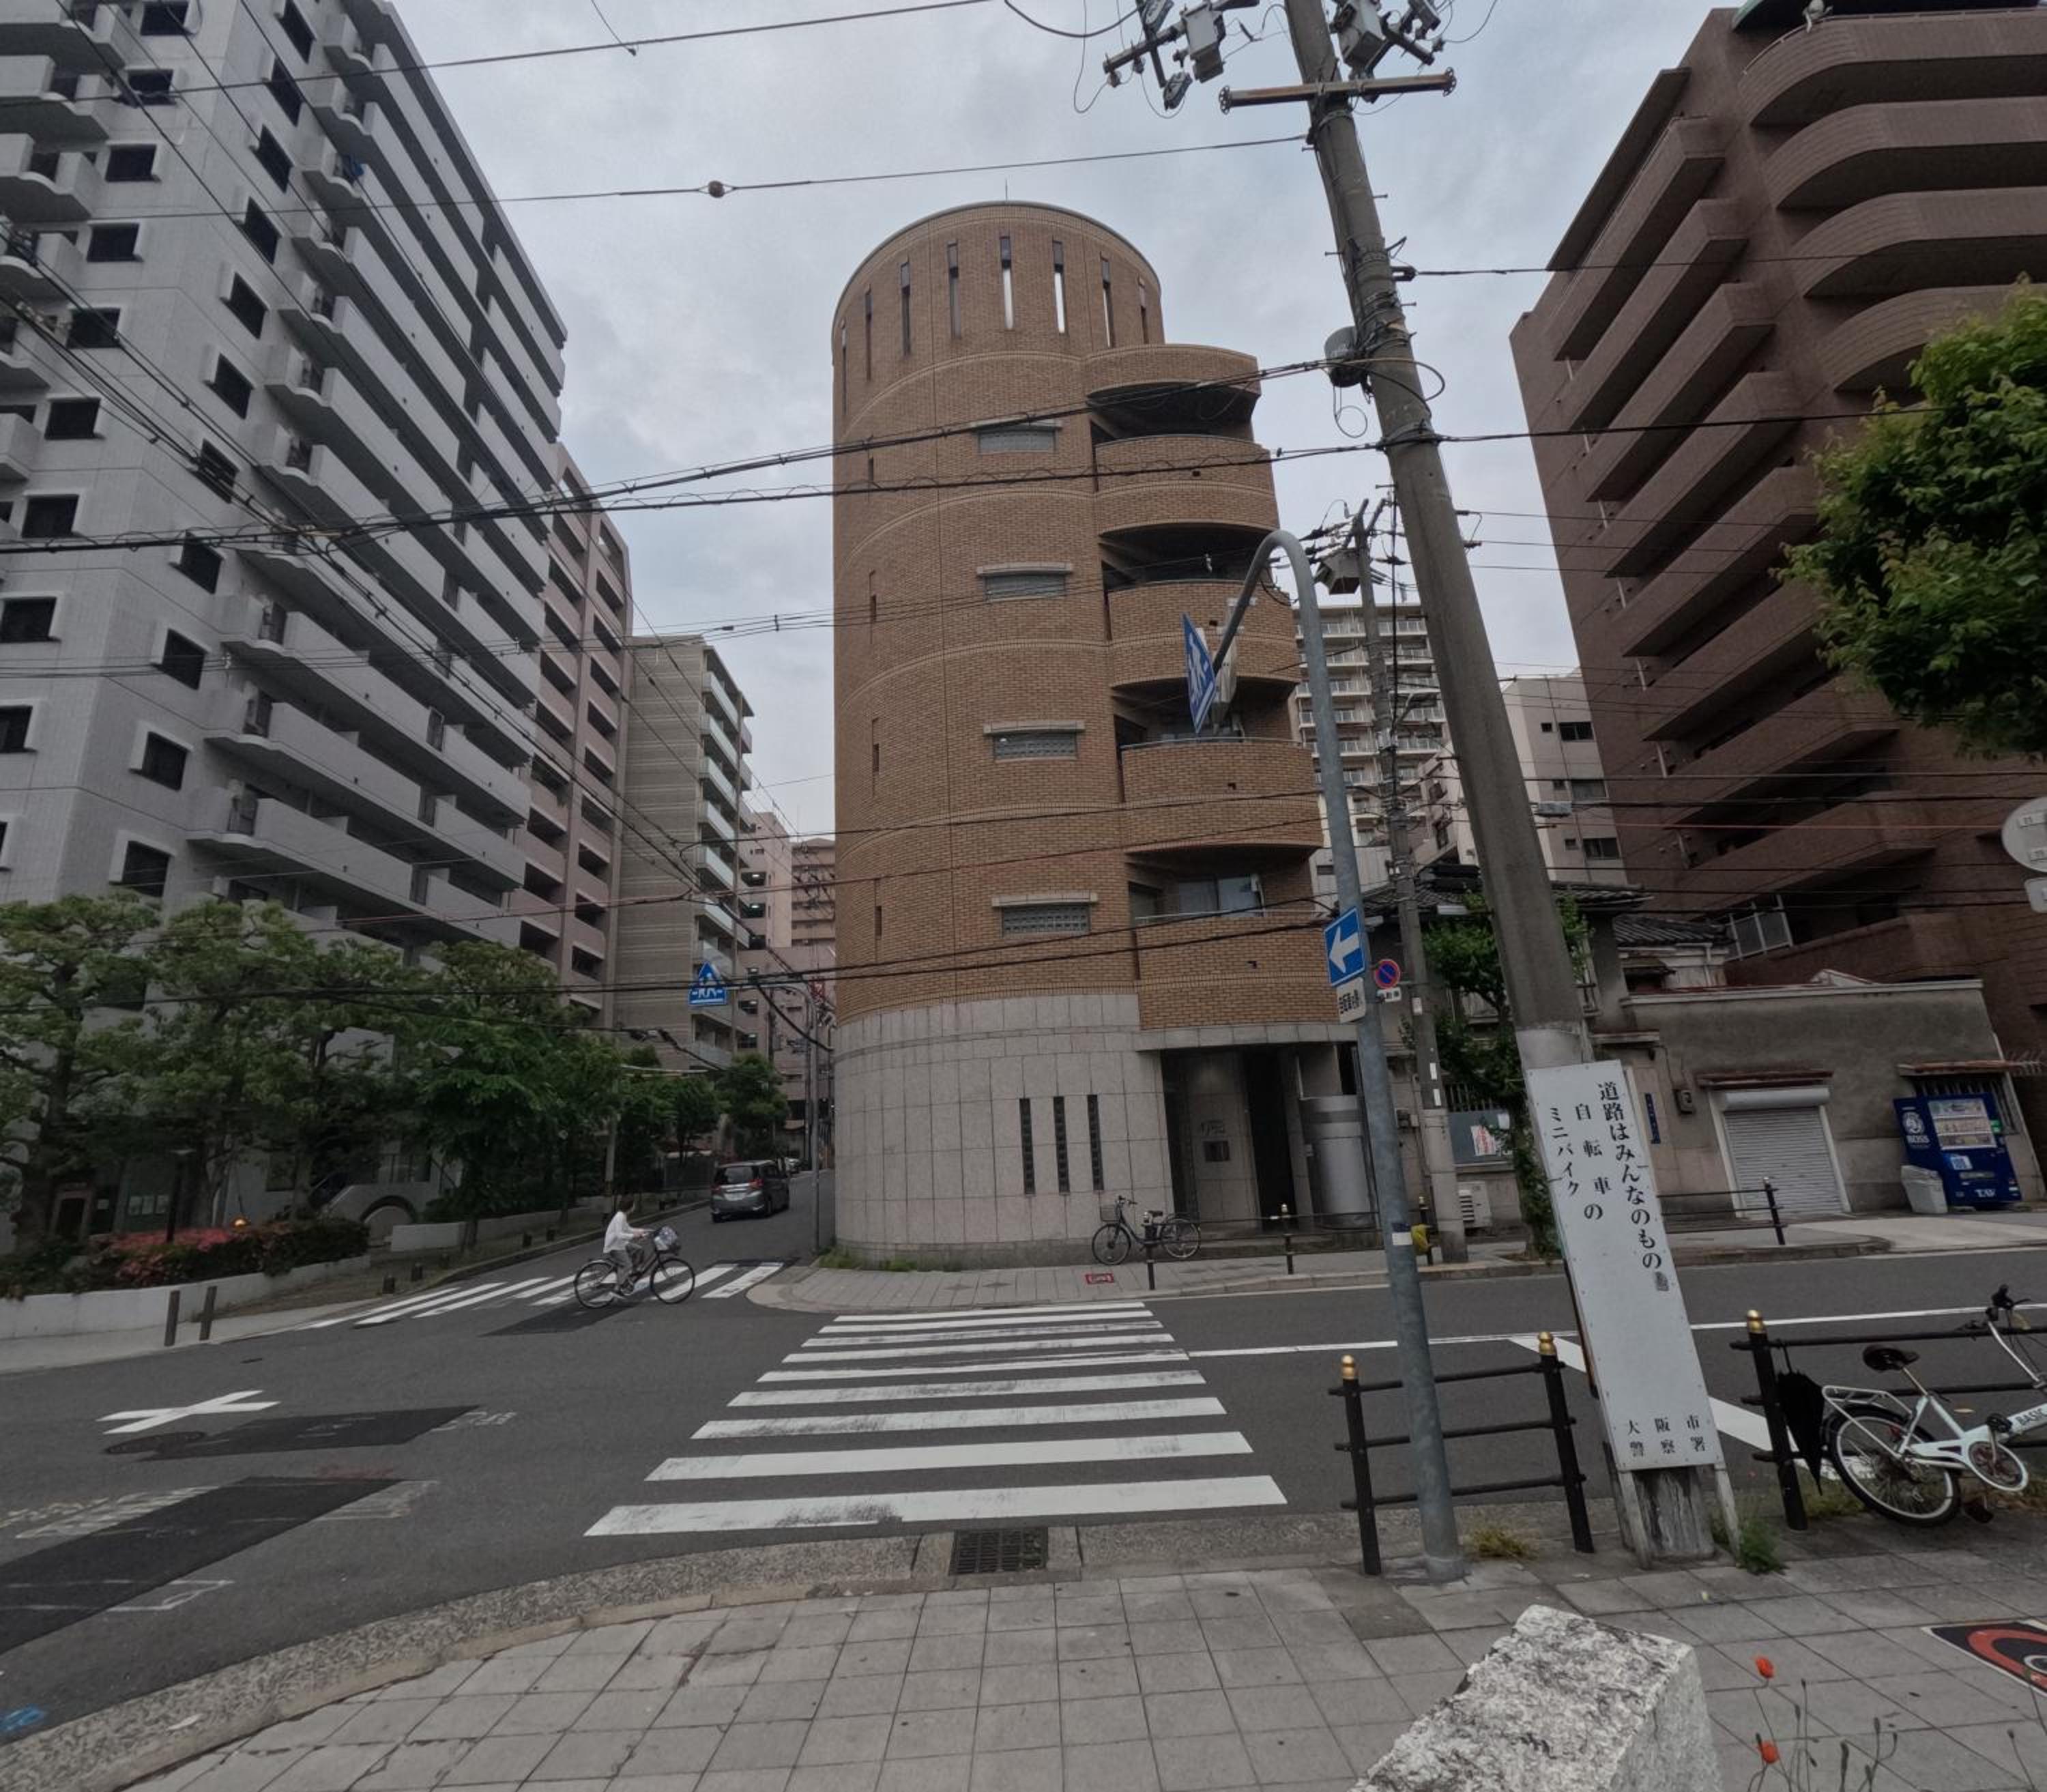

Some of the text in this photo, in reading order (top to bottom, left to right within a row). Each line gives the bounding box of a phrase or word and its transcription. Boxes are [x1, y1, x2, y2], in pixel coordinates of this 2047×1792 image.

[1550, 1107, 1579, 1196] ミニバイク
[1575, 1103, 1611, 1195] 自転車
[1597, 1081, 1661, 1269] 道路はみんなのもの
[1584, 1203, 1603, 1220] の
[1628, 1414, 1700, 1435] 大阪市
[2015, 1407, 2042, 1426] BASIC
[1629, 1436, 1706, 1457] 警察署
